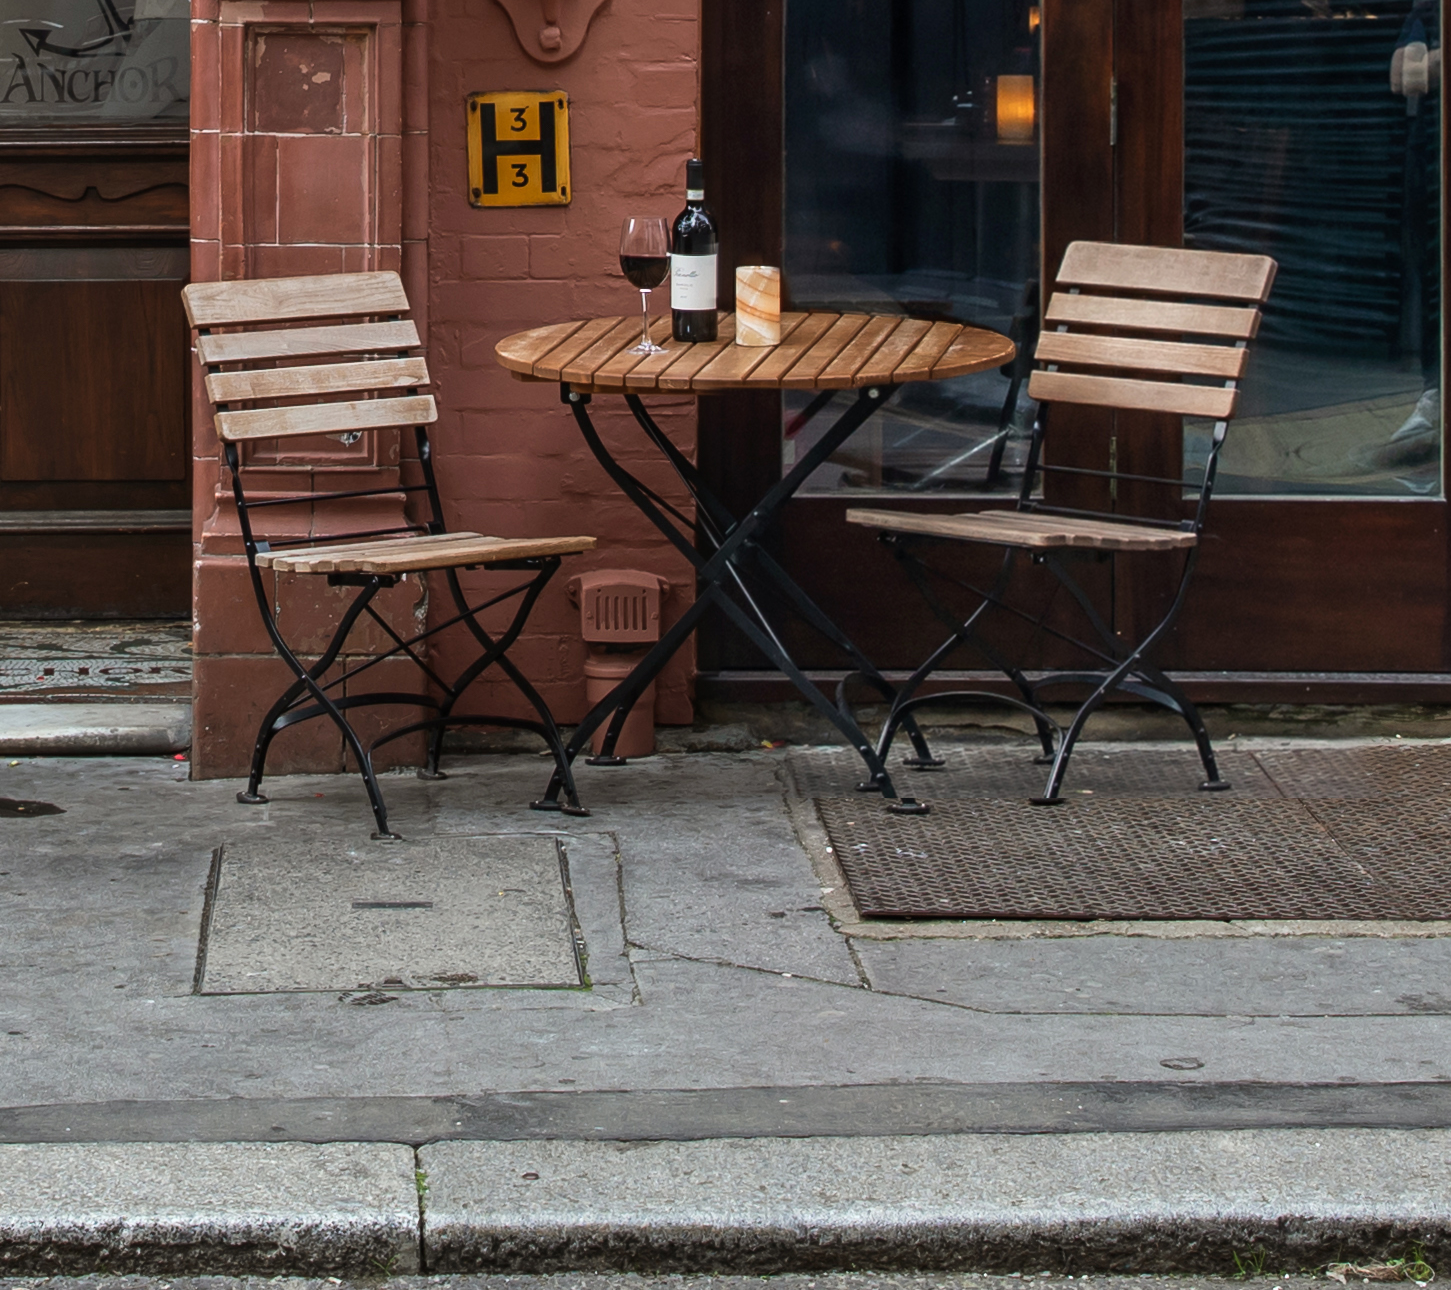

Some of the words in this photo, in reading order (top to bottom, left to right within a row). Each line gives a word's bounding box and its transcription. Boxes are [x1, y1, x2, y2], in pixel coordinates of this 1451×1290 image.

[0, 51, 190, 105] ANCHOR
[509, 107, 528, 132] 3
[479, 100, 557, 194] H
[511, 164, 530, 187] 3
